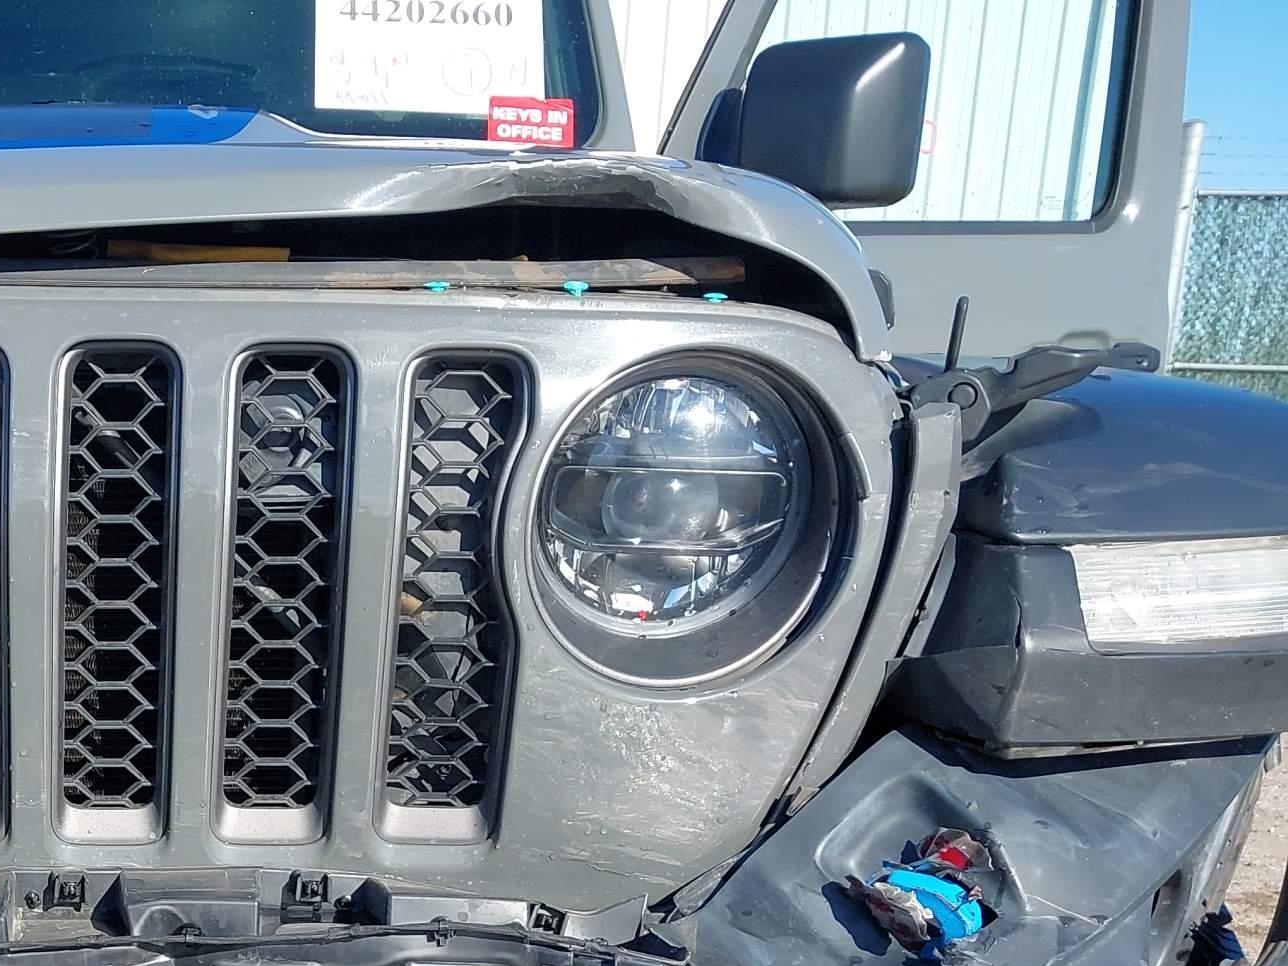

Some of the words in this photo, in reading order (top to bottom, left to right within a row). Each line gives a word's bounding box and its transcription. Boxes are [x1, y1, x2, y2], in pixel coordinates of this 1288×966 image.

[339, 0, 513, 27] 44202660
[492, 106, 543, 123] KEYS
[547, 110, 568, 125] IN
[496, 123, 563, 141] OFFICE
